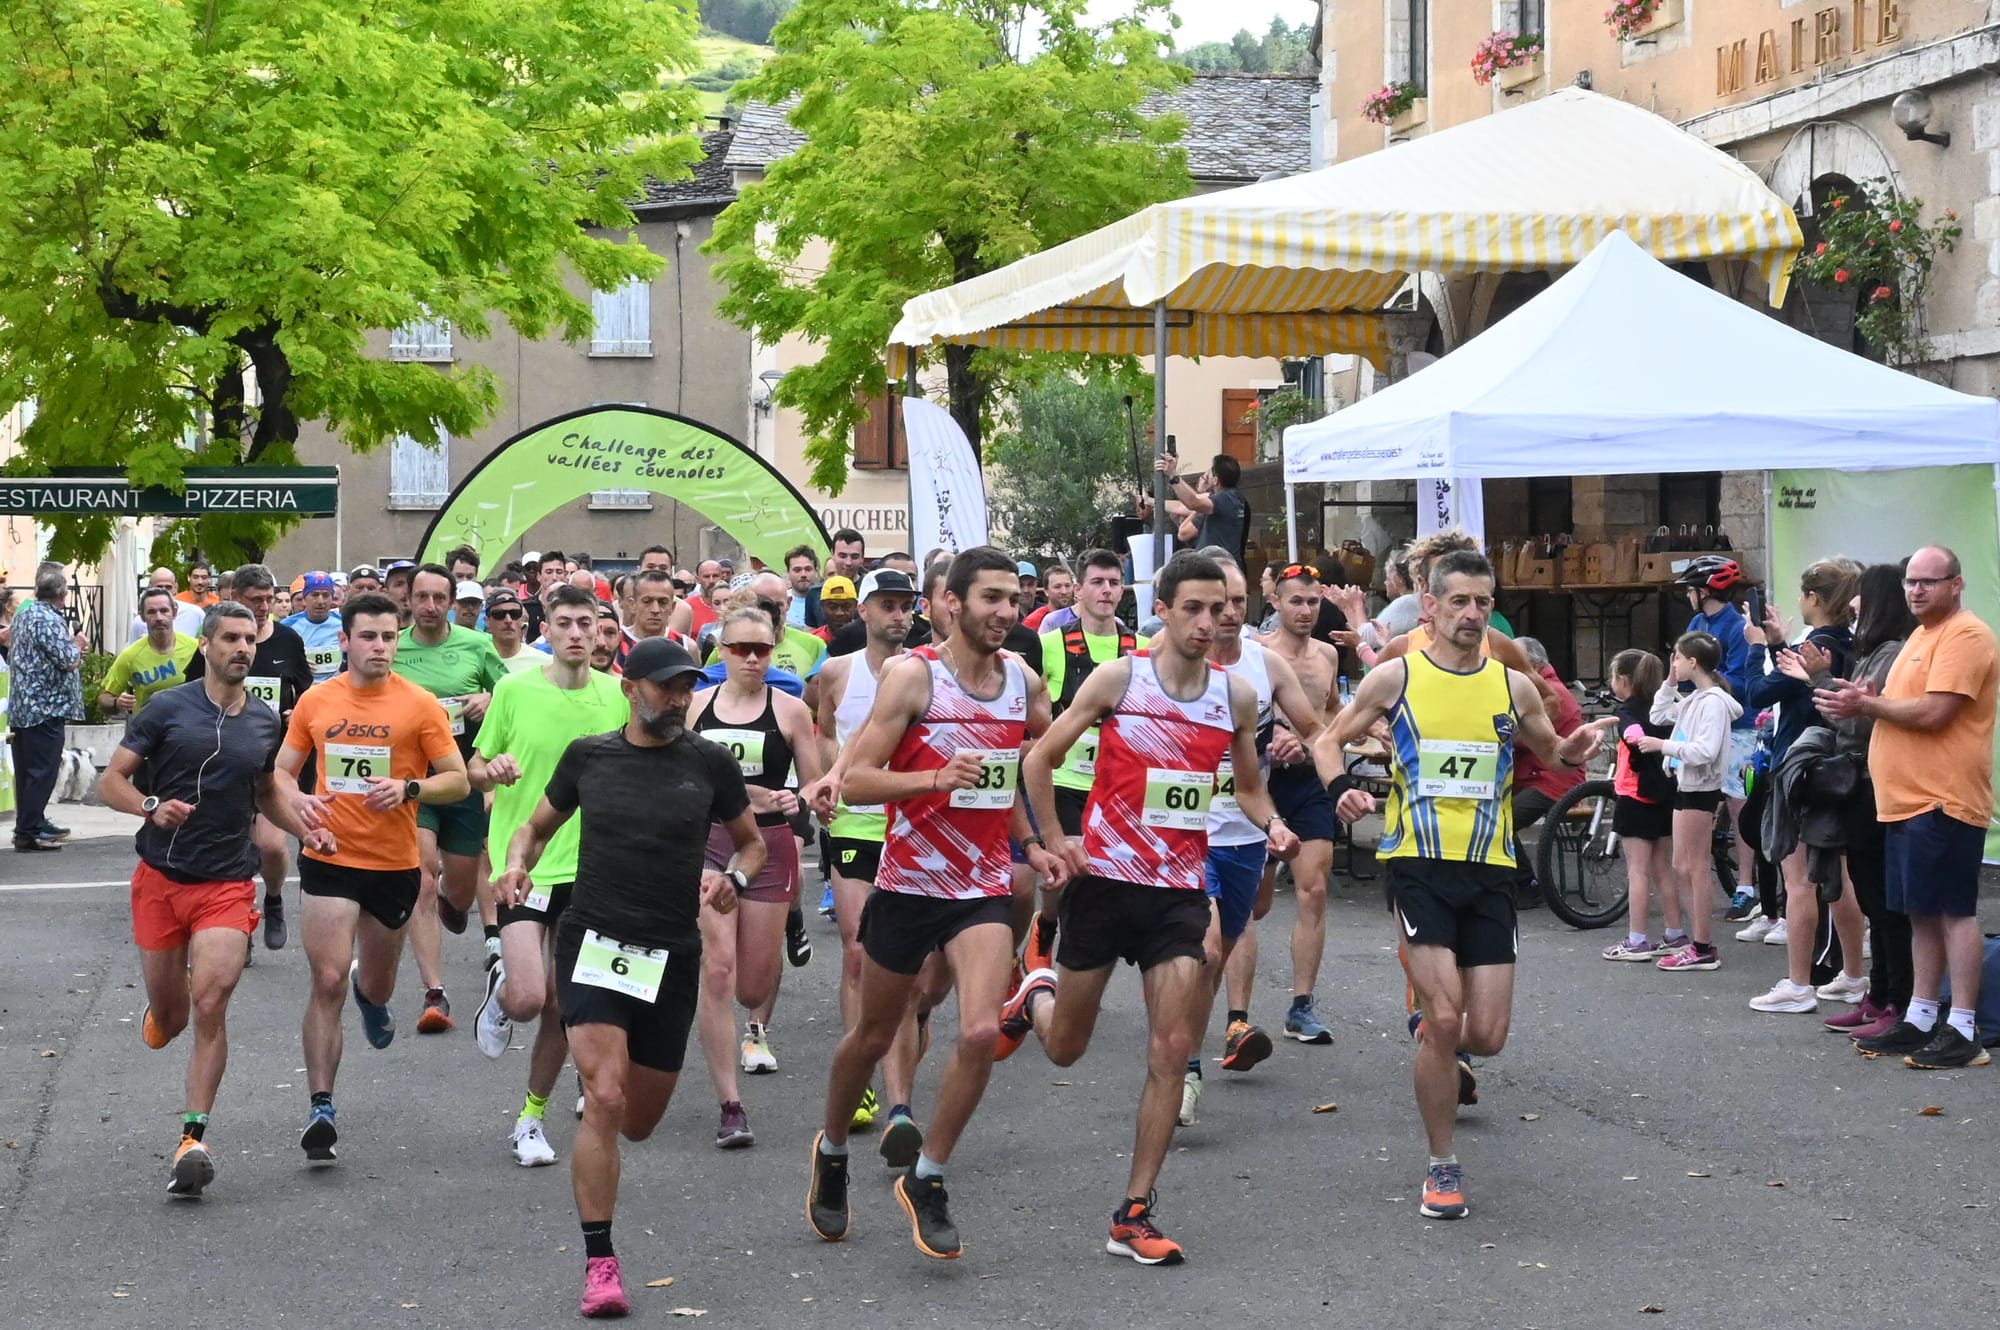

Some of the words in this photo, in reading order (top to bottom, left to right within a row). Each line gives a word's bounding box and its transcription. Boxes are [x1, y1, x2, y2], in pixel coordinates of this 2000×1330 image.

[1716, 0, 1902, 97] MAIRIE
[562, 433, 667, 463] Challenge
[681, 446, 715, 460] des
[547, 454, 622, 473] vallées
[635, 462, 725, 479] cévenoles
[0, 489, 143, 508] ESTAURANT
[185, 489, 297, 509] PIZZERIA
[820, 508, 909, 531] OUCHER
[315, 652, 333, 665] 88
[132, 659, 176, 686] RUN
[347, 724, 390, 738] asics
[719, 742, 745, 761] 0
[1086, 746, 1095, 761] 1
[341, 757, 372, 777] 76
[975, 765, 1006, 789] 83
[1439, 756, 1478, 779] 47
[1165, 786, 1200, 810] 60
[611, 956, 630, 976] 6
